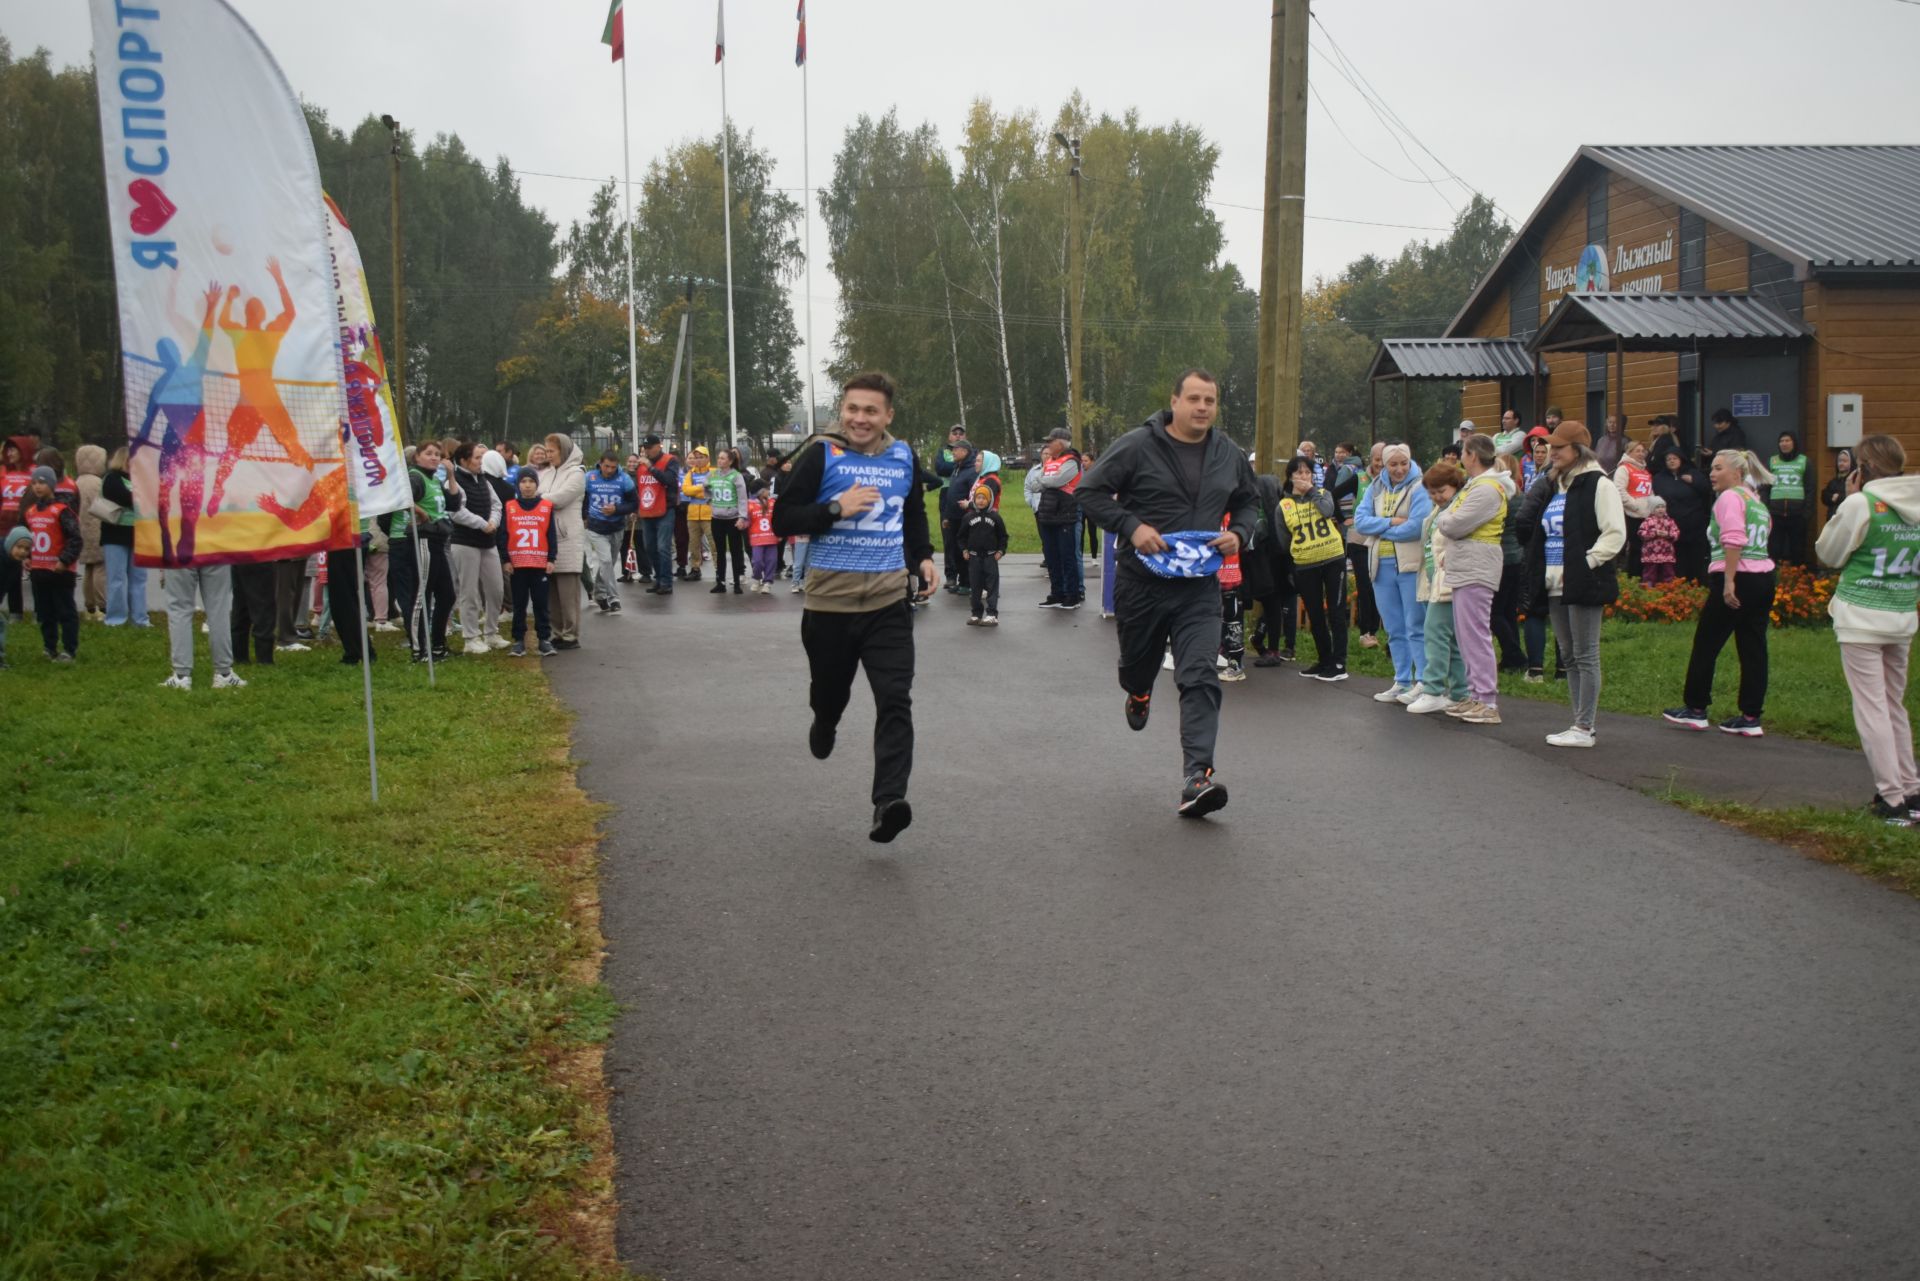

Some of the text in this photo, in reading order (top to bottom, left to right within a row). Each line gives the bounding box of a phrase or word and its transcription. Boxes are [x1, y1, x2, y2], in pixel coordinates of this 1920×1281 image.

[114, 0, 179, 271] Я СПОРТ
[1612, 229, 1673, 274] Лыжный
[640, 475, 659, 485] СУДЬ
[838, 466, 904, 479] ТУКАЕВСКИЙ
[855, 475, 892, 488] РАЙОН
[759, 518, 770, 532] 8
[1293, 517, 1331, 545] 318
[515, 528, 539, 548] 21
